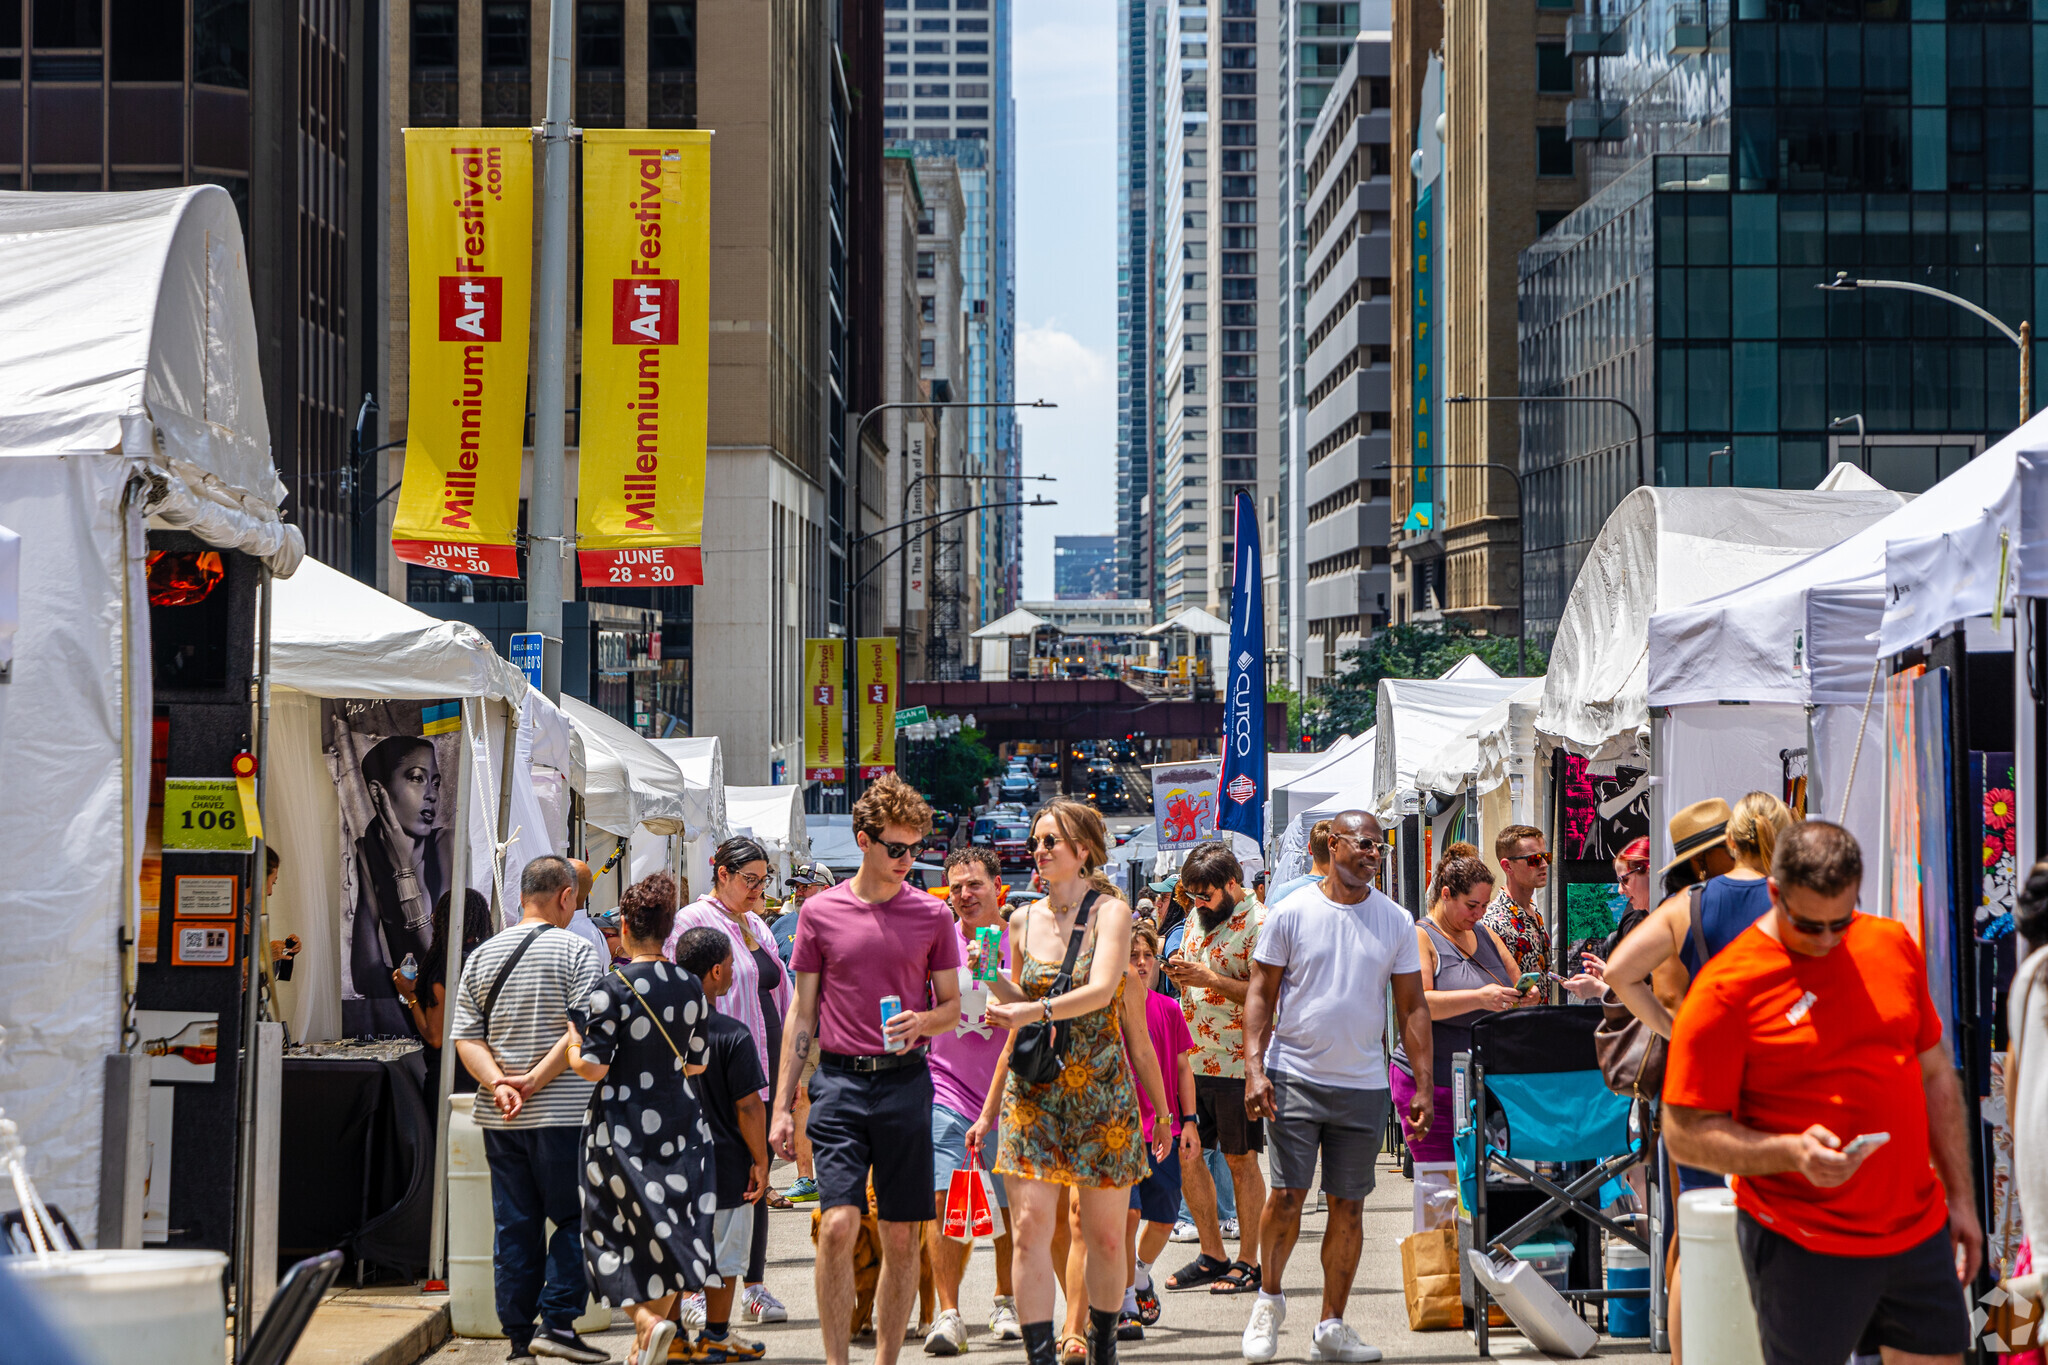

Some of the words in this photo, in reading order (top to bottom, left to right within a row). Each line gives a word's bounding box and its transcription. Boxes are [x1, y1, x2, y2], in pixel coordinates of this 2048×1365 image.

[487, 147, 502, 201] .com
[451, 147, 484, 272] Festival
[628, 149, 662, 275] Festival
[1417, 220, 1428, 340] SELF
[456, 282, 485, 337] Art
[630, 284, 661, 340] Art
[442, 345, 484, 529] Millennium
[624, 348, 660, 531] Millennium
[1417, 363, 1428, 483] PARK
[912, 440, 922, 455] Art
[912, 458, 922, 468] of
[424, 555, 447, 568] 28
[467, 560, 490, 573] 30
[429, 544, 480, 559] JUNE
[614, 549, 665, 564] JUNE
[912, 555, 922, 575] The
[608, 567, 633, 582] 28
[651, 565, 675, 582] 30
[818, 645, 829, 684] Festival
[871, 644, 883, 683] Festival
[818, 686, 829, 704] Art
[873, 684, 884, 703] Art
[872, 704, 884, 762] Millennium
[1236, 672, 1251, 757] CUTCO
[817, 706, 829, 764] Millennium
[181, 810, 236, 830] 106
[191, 801, 225, 809] CHAVEZ
[1178, 841, 1200, 849] SERIO
